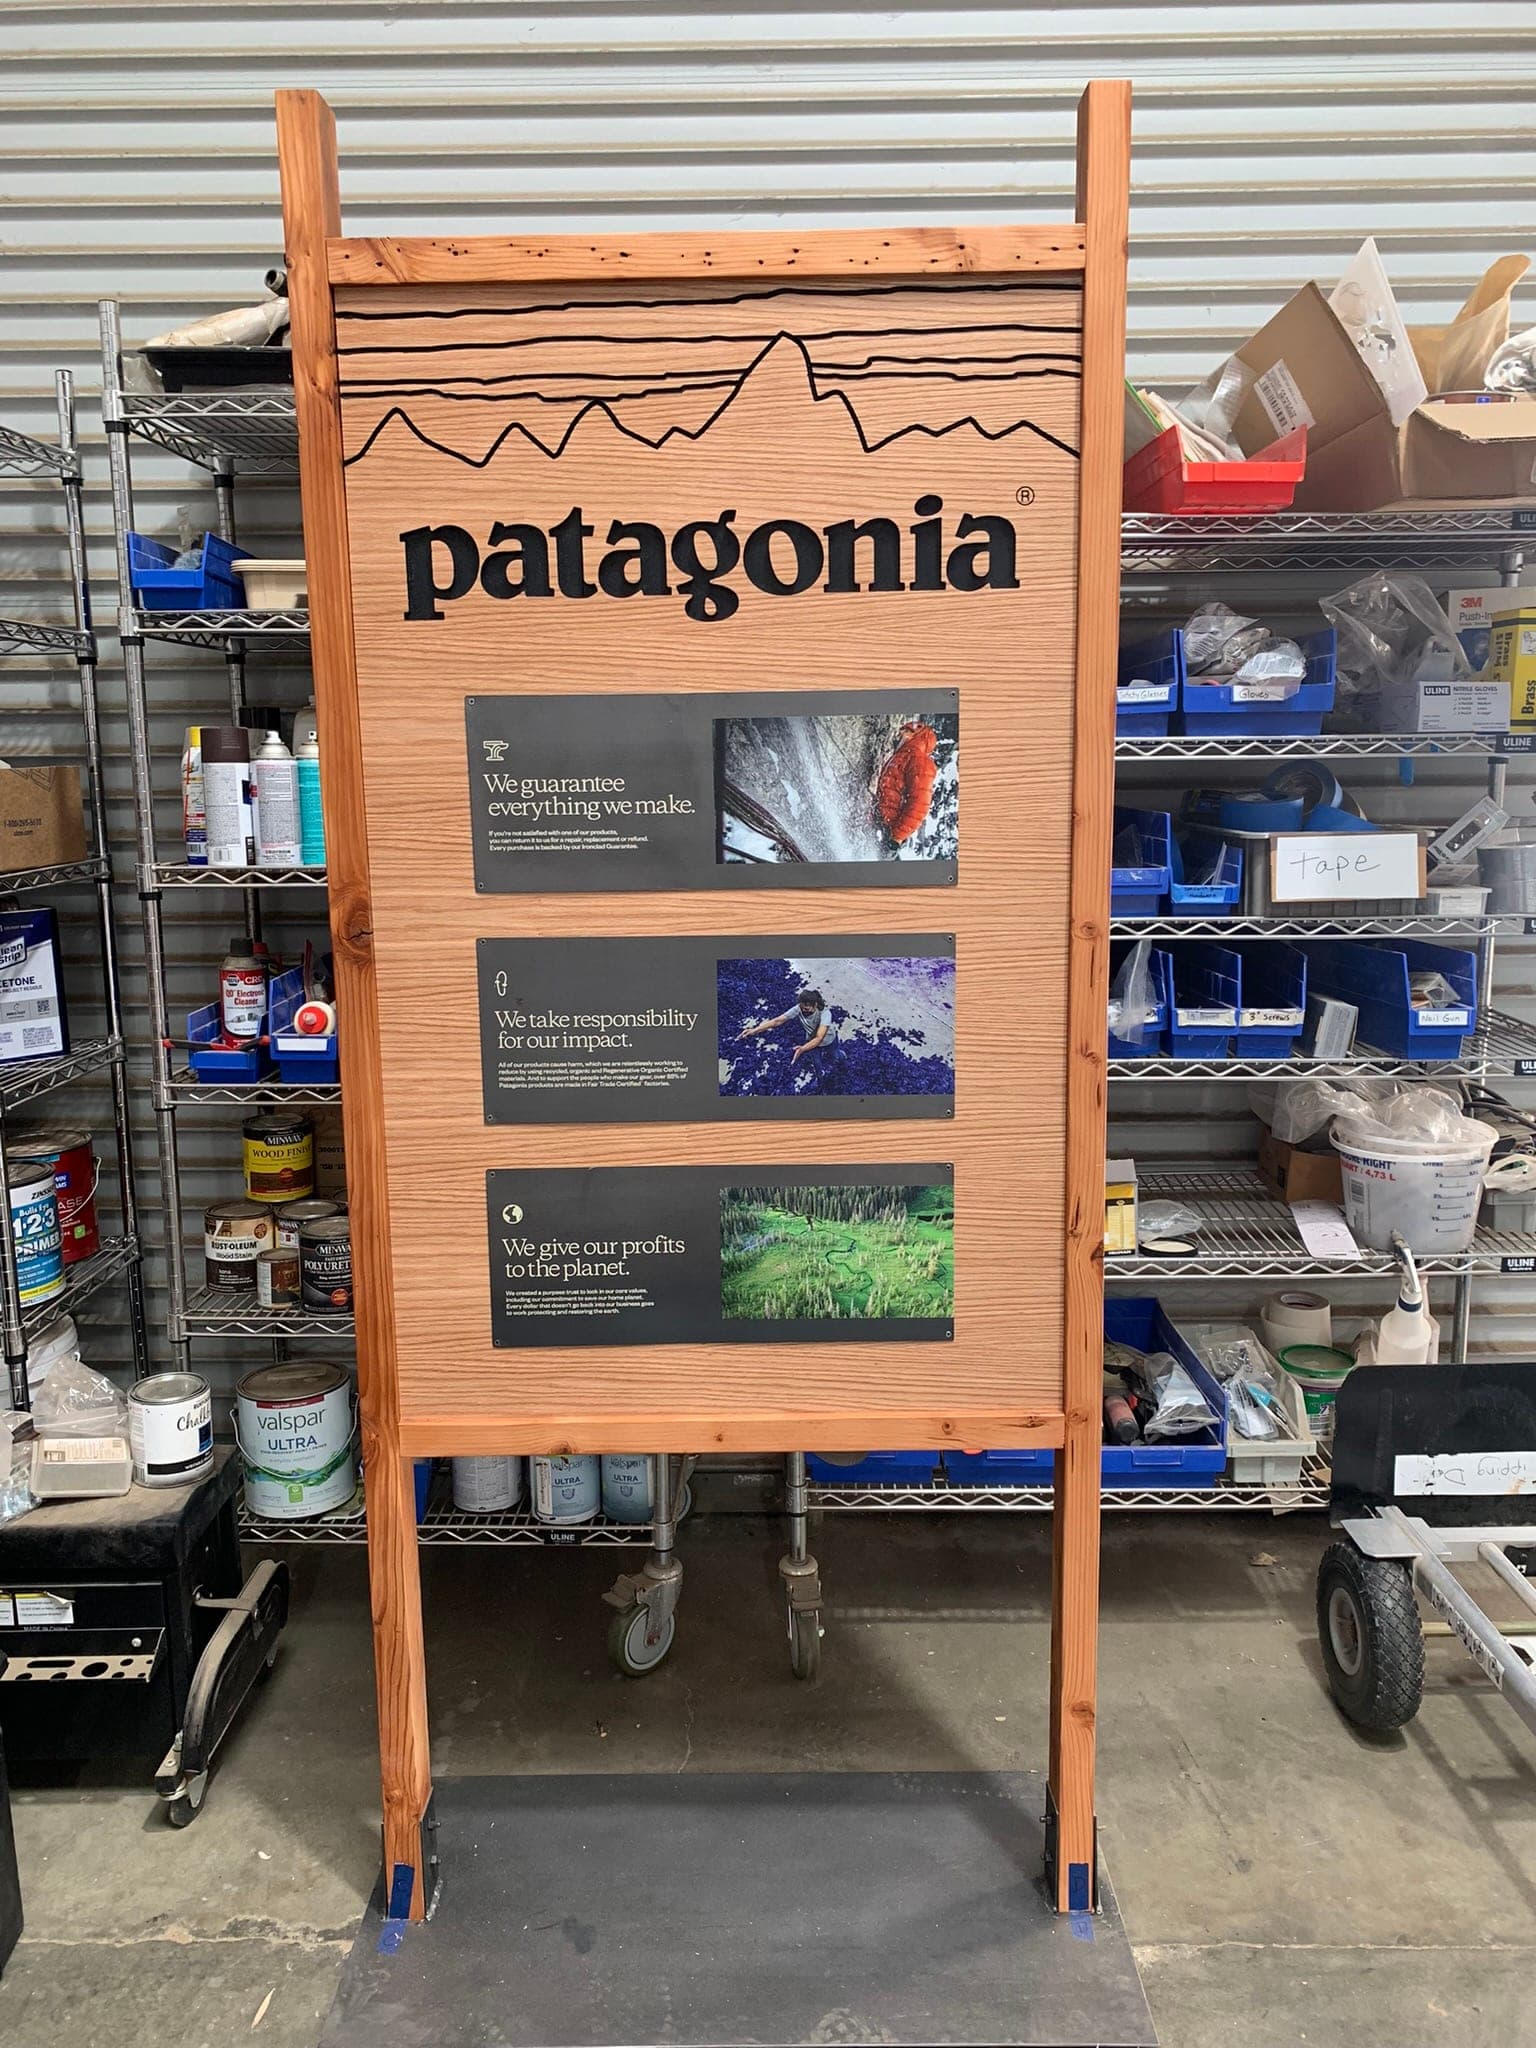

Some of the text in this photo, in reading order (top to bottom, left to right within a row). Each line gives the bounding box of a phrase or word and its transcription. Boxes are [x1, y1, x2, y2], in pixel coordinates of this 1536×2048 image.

[399, 494, 1020, 622] patagonia
[1461, 597, 1482, 608] 3M
[1240, 688, 1269, 699] Gloves
[1503, 737, 1531, 746] ULINE
[483, 774, 625, 798] We guarantee
[488, 794, 696, 821] everything we make.
[1290, 851, 1380, 881] tape
[0, 943, 24, 955] lean
[0, 976, 36, 988] ETONE
[494, 1009, 699, 1031] We take responsibility
[1263, 1013, 1290, 1021] Screws
[1422, 1014, 1460, 1022] Nail Gun
[498, 1031, 633, 1052] for our impact.
[253, 1149, 284, 1158] WOOD
[1389, 1173, 1396, 1181] L
[57, 1196, 83, 1209] ASE
[15, 1232, 60, 1258] PRIMER
[319, 1244, 351, 1254] MINWA
[501, 1235, 686, 1261] We give our profits
[304, 1259, 351, 1271] POLYURET
[1507, 1258, 1535, 1267] ULINE
[505, 1258, 630, 1282] to the planet.
[257, 1409, 326, 1434] valspar
[268, 1435, 318, 1451] ULTRA
[554, 1476, 581, 1485] ULTRA
[614, 1474, 638, 1482] ULTRA
